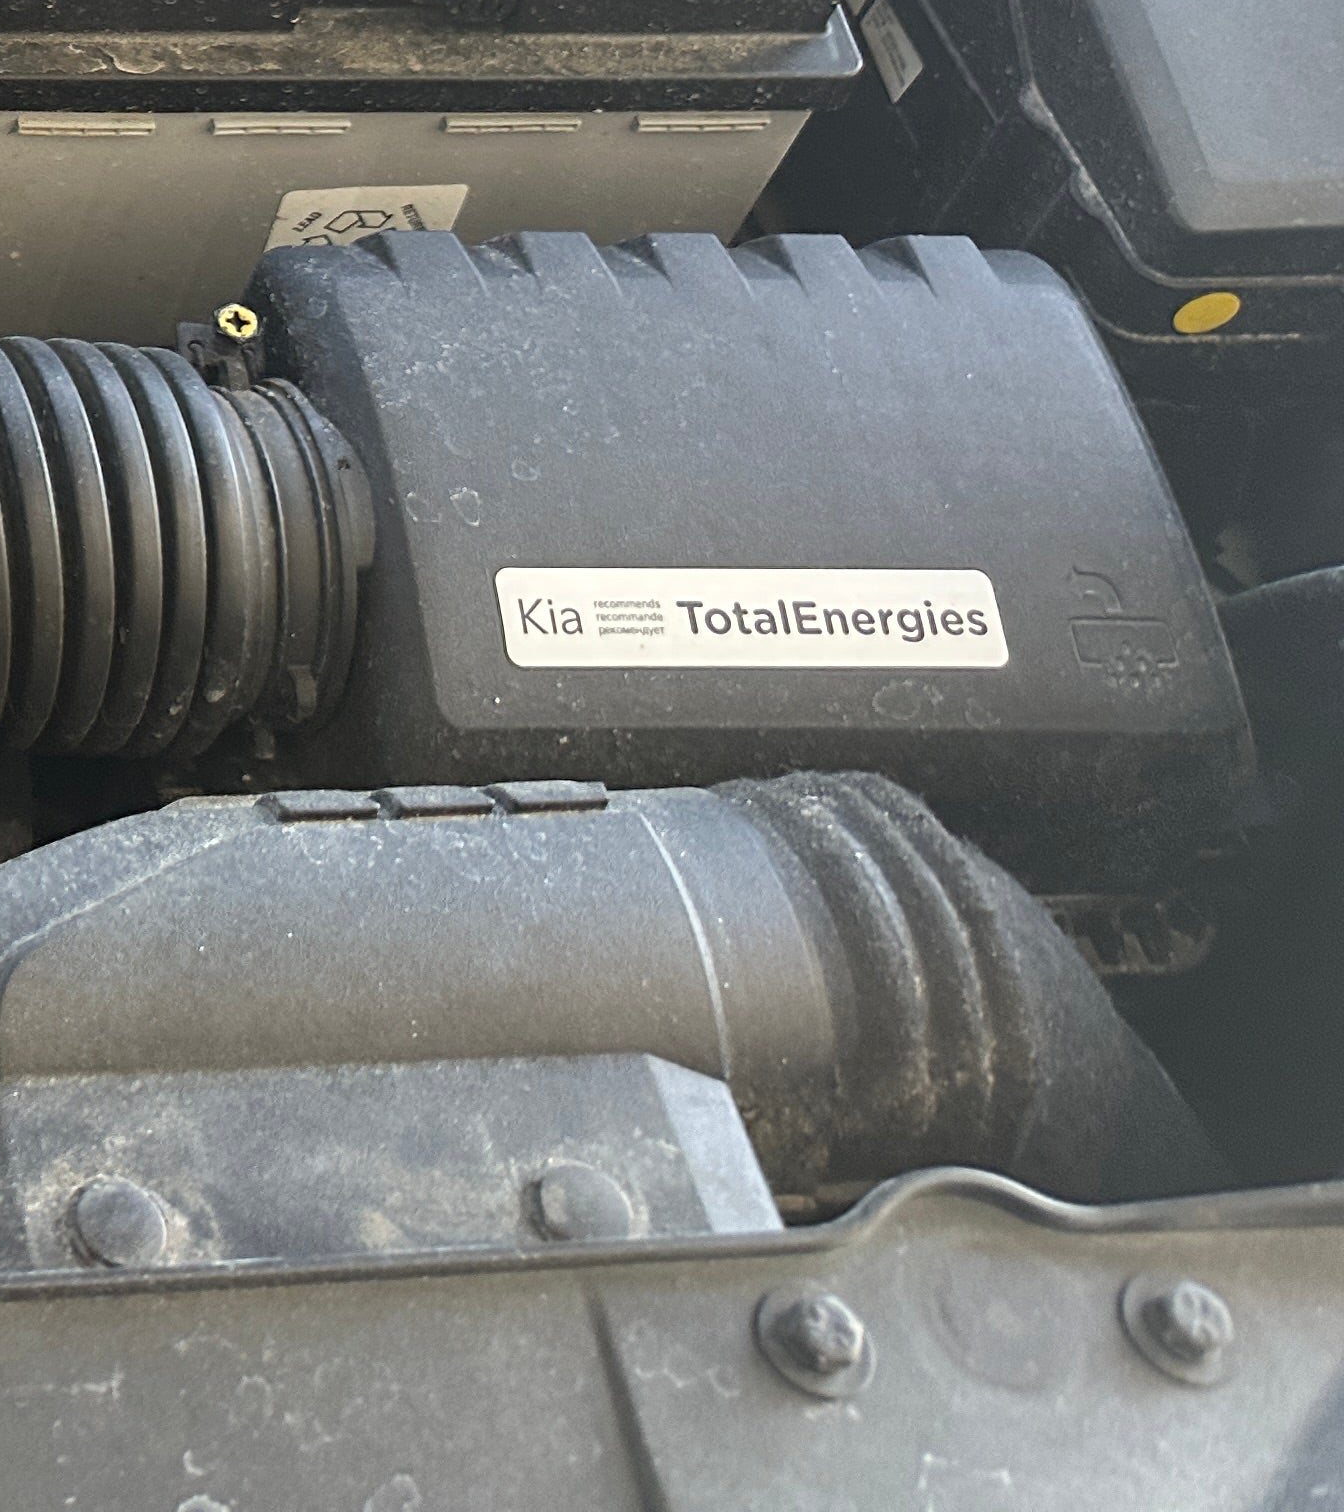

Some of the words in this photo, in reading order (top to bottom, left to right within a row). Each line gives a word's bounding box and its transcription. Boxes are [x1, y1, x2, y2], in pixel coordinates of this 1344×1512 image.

[292, 211, 323, 233] LEAD
[593, 598, 661, 609] recommends
[516, 597, 584, 637] Kia
[675, 598, 989, 643] TotalEnergies
[596, 612, 664, 622] recommande
